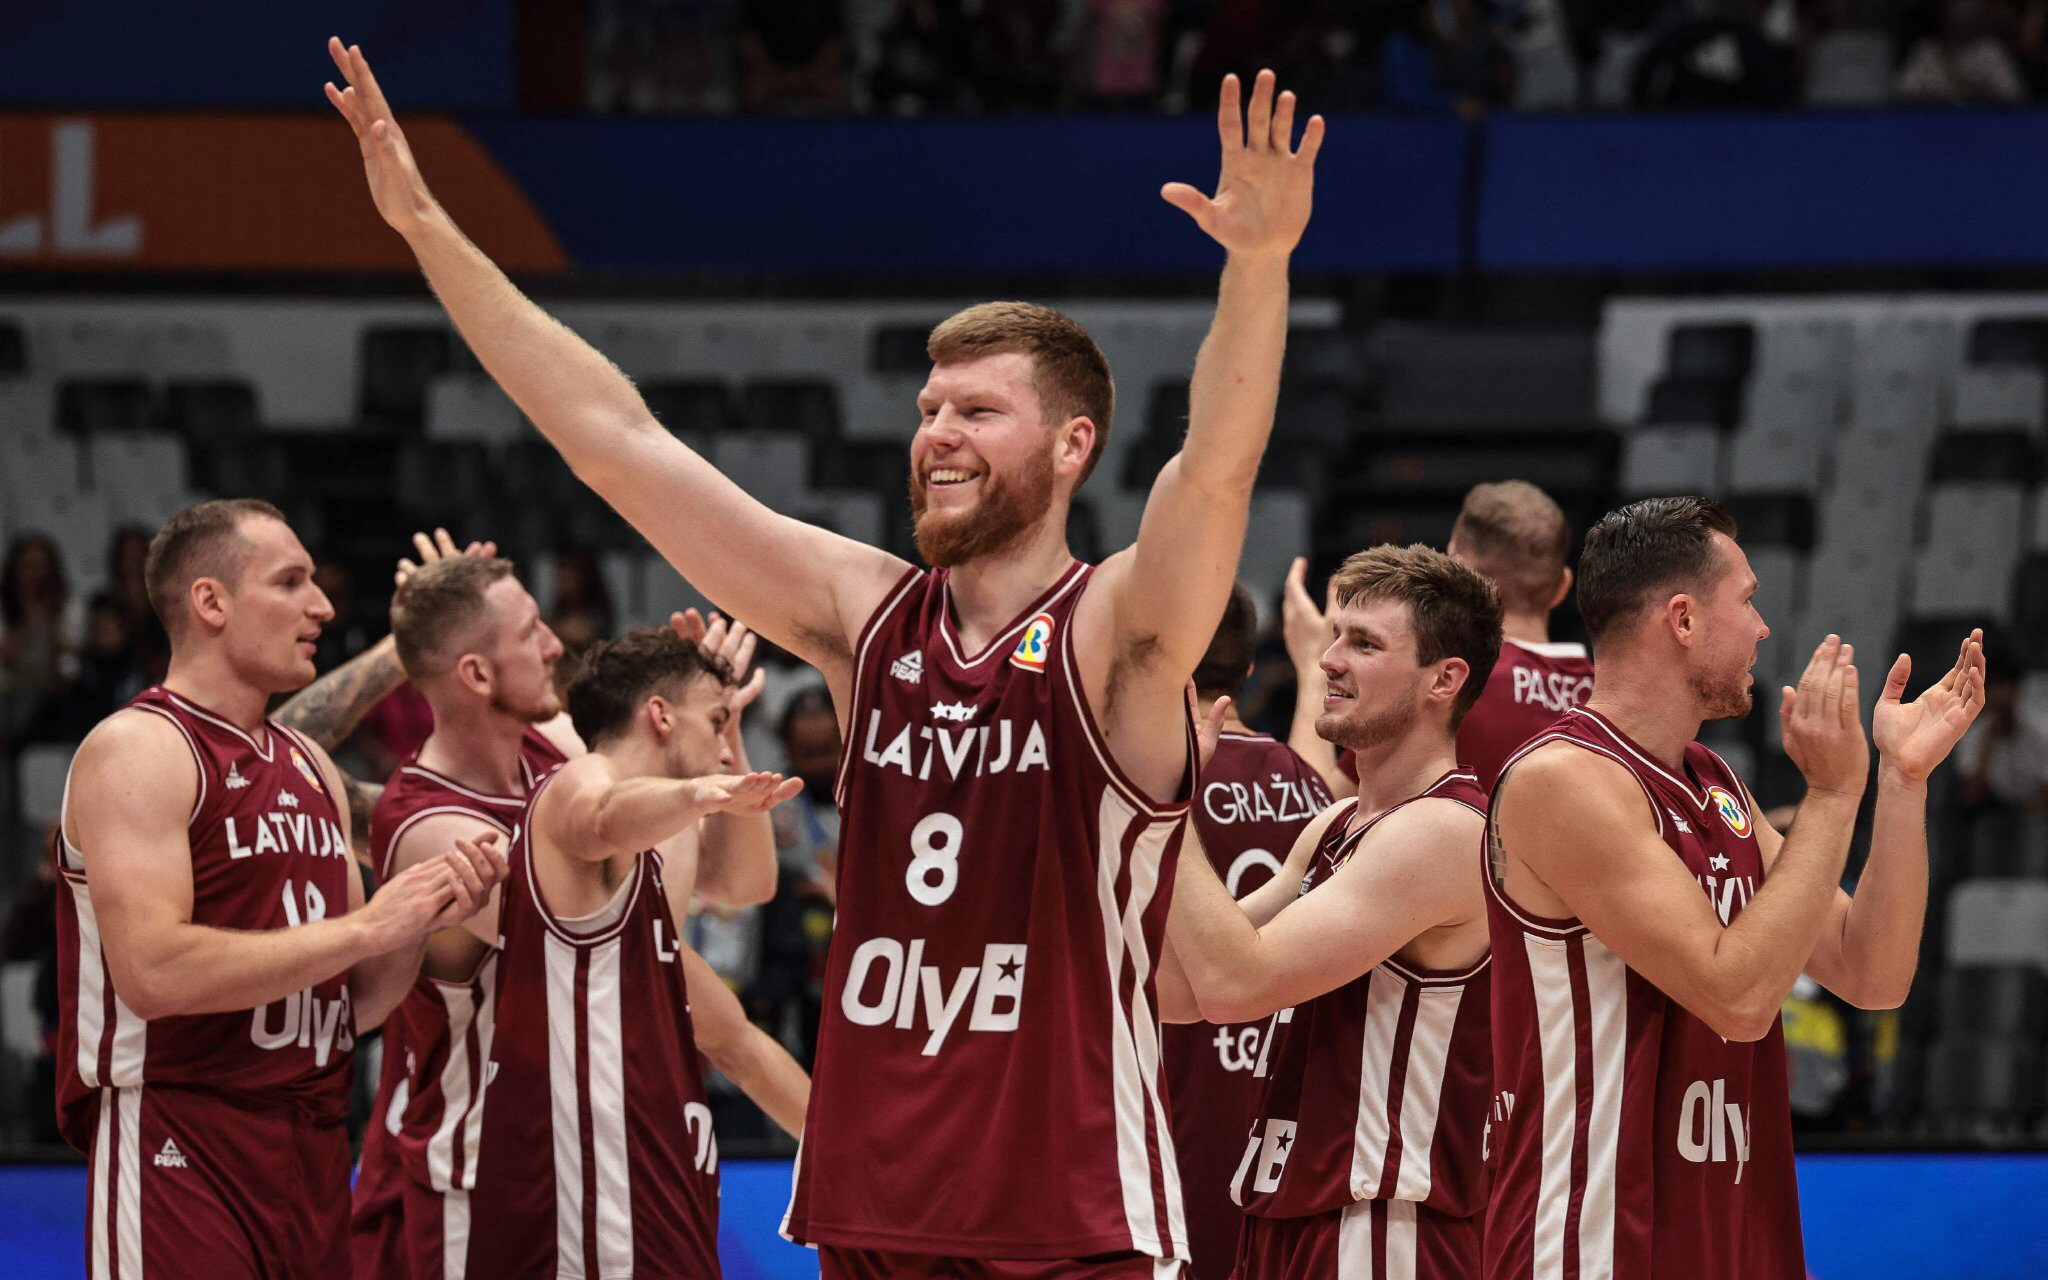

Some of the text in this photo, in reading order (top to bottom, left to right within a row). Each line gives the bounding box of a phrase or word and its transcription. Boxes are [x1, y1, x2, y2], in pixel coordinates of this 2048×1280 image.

[863, 708, 1051, 781] LATVIJA
[224, 811, 348, 861] LATVIJA
[905, 811, 964, 907] 8
[841, 937, 1028, 1057] OlyB
[152, 1153, 189, 1169] PEAK
[1676, 1078, 1751, 1185] Oly
